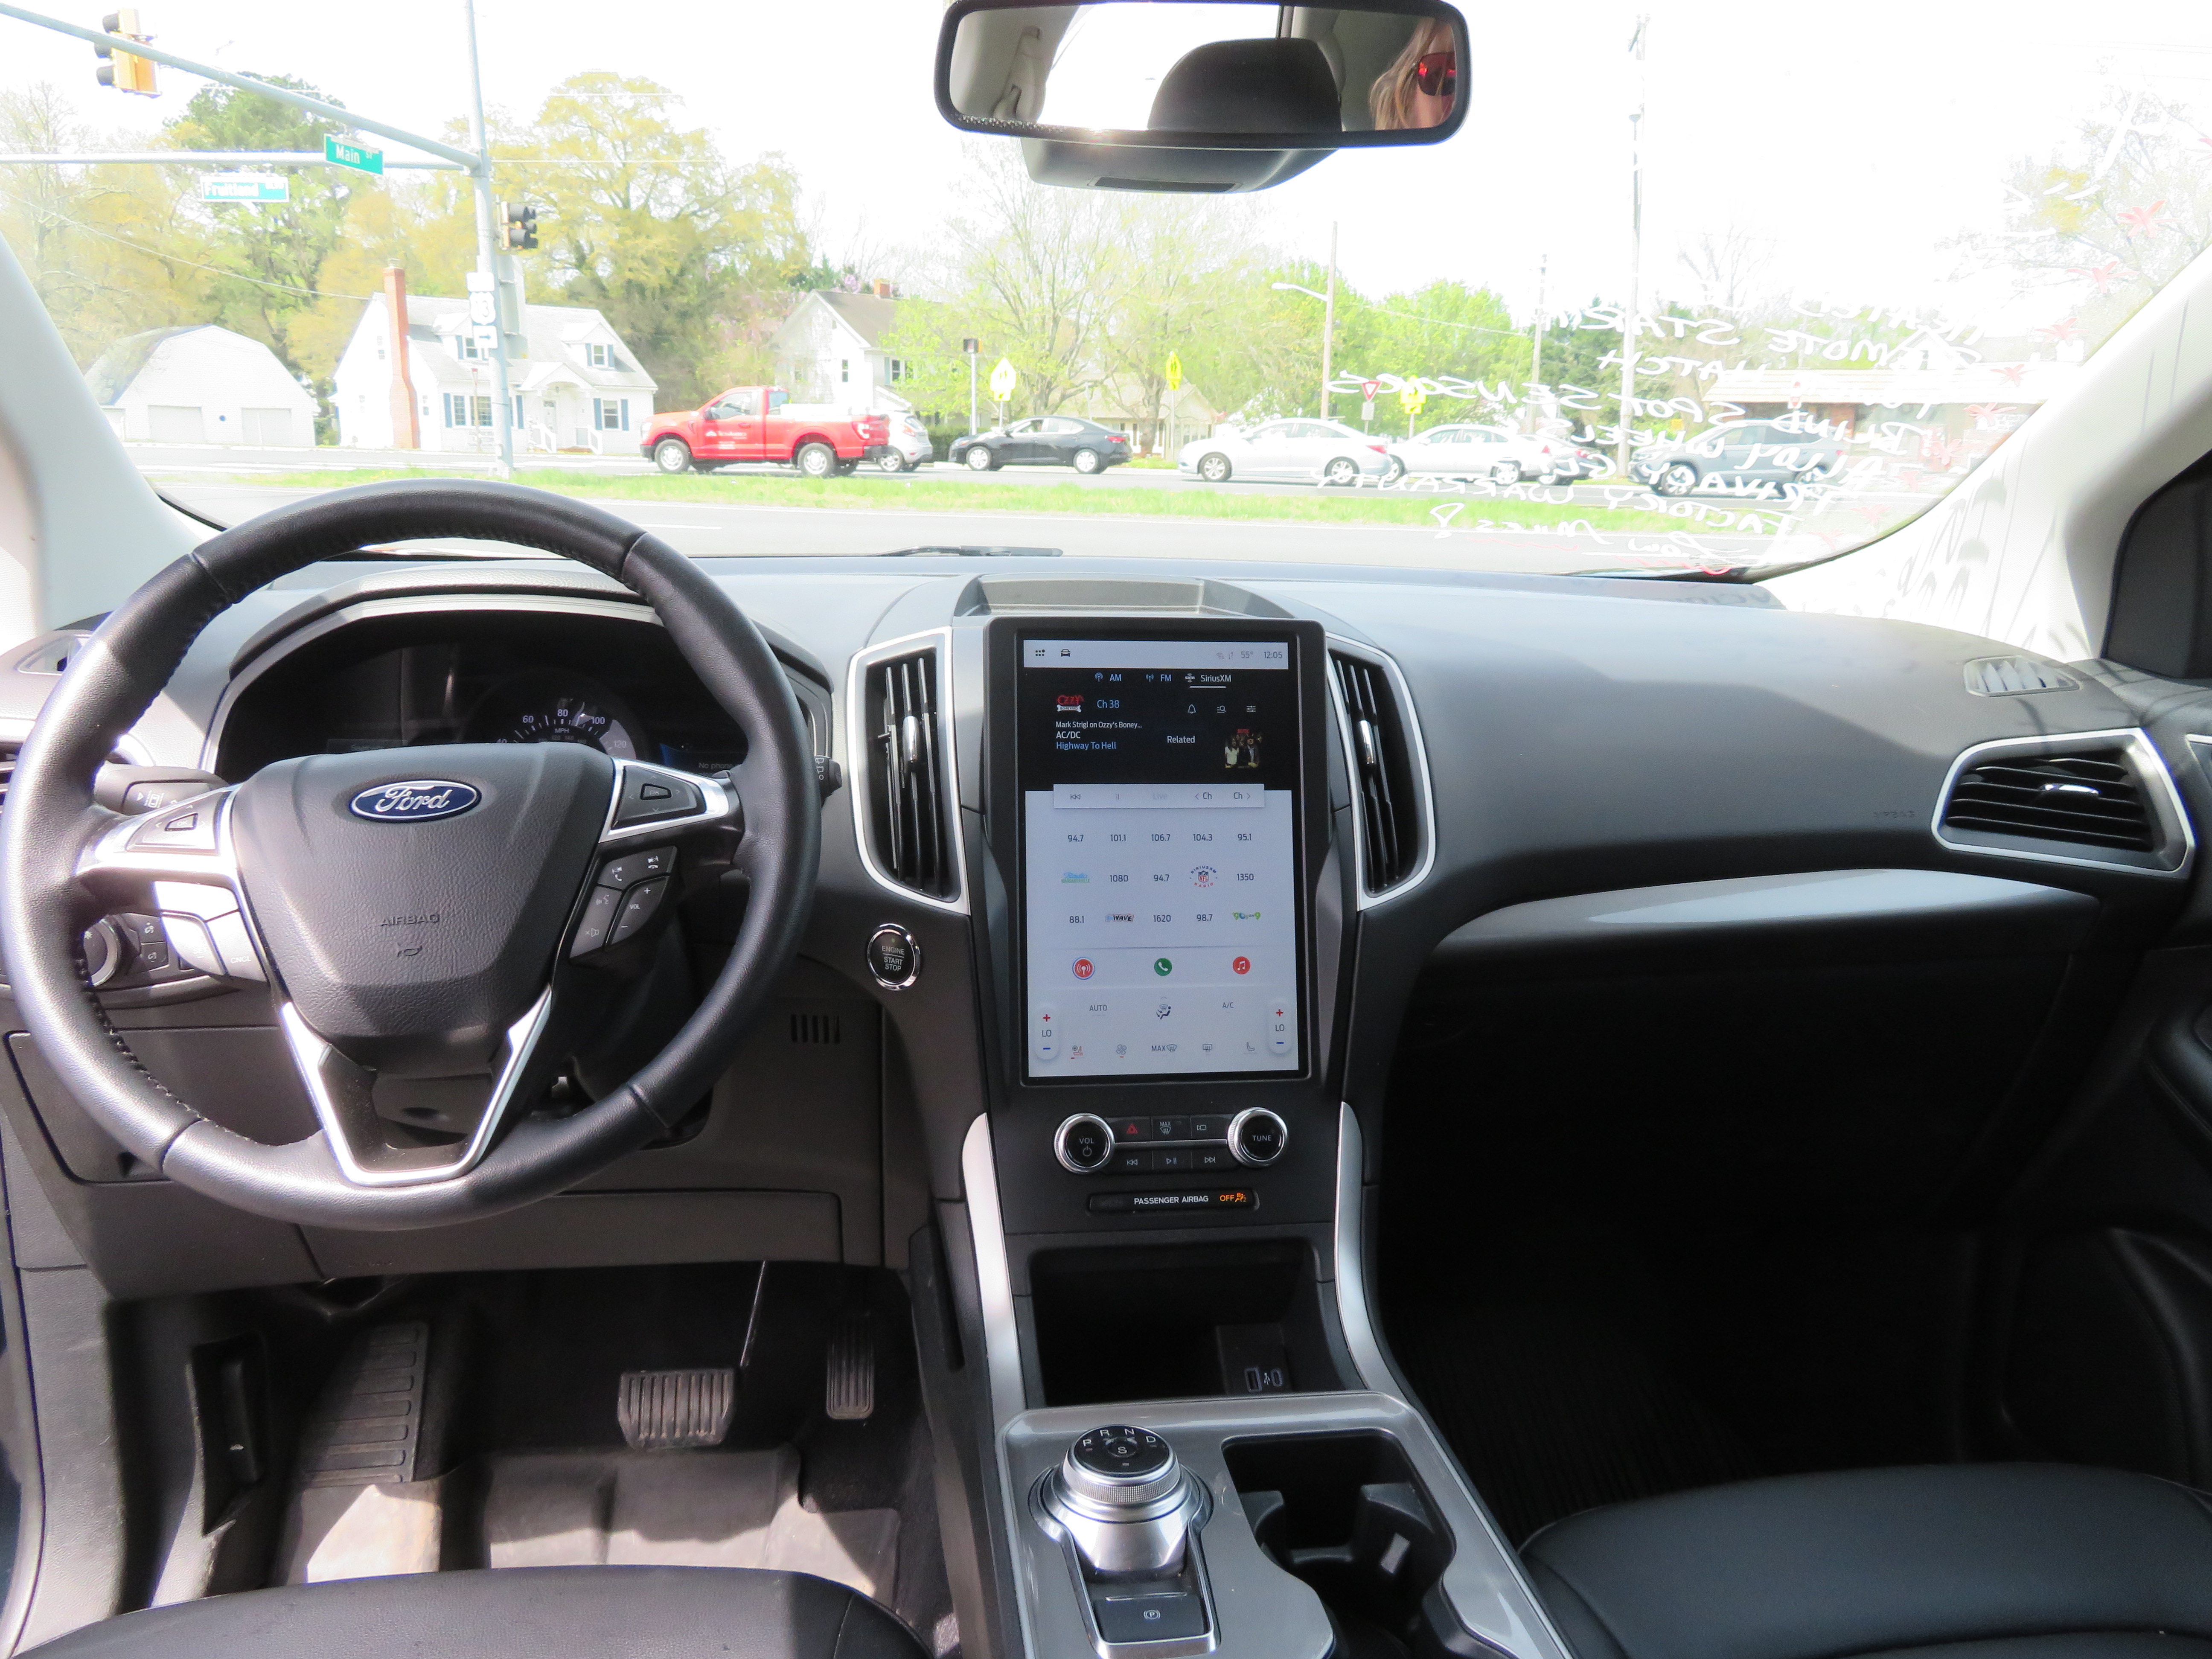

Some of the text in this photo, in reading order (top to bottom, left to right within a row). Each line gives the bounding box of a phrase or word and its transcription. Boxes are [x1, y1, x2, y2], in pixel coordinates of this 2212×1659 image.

[336, 144, 361, 165] Main
[205, 182, 259, 197] Fruitland
[475, 300, 490, 317] 13
[1109, 674, 1122, 682] AM
[1160, 674, 1172, 683] FM
[1200, 674, 1232, 683] SiriusXM
[1097, 700, 1120, 709] Ch 38
[557, 709, 568, 717] 80
[522, 715, 534, 723] 60
[591, 716, 605, 725] 100
[1072, 721, 1089, 729] Strigl
[1098, 721, 1118, 729] Ozzy's
[1056, 731, 1081, 739] AC/DC
[1167, 735, 1196, 744] Related
[1056, 742, 1117, 751] Highway To Hell
[375, 784, 453, 812] Ford
[1202, 792, 1213, 800] Ch
[1233, 792, 1243, 800] Ch
[1067, 834, 1084, 843] 94.7
[1110, 834, 1127, 842] 101.1
[1151, 834, 1171, 842] 106.7
[1193, 833, 1213, 842] 104.3
[1237, 833, 1252, 841] 95.1
[1109, 874, 1129, 882] 1080
[1153, 874, 1170, 882] 94.7
[1236, 873, 1254, 881] 1350
[380, 914, 440, 927] AIRBAG
[1153, 914, 1172, 923] 1620
[881, 945, 905, 955] ENGINE
[230, 955, 252, 964] CNCL
[883, 956, 903, 965] START
[885, 963, 902, 972] STOP
[1042, 1029, 1052, 1038] LO
[1134, 1197, 1179, 1205] PASSENGER
[1182, 1195, 1209, 1203] AIRBAG
